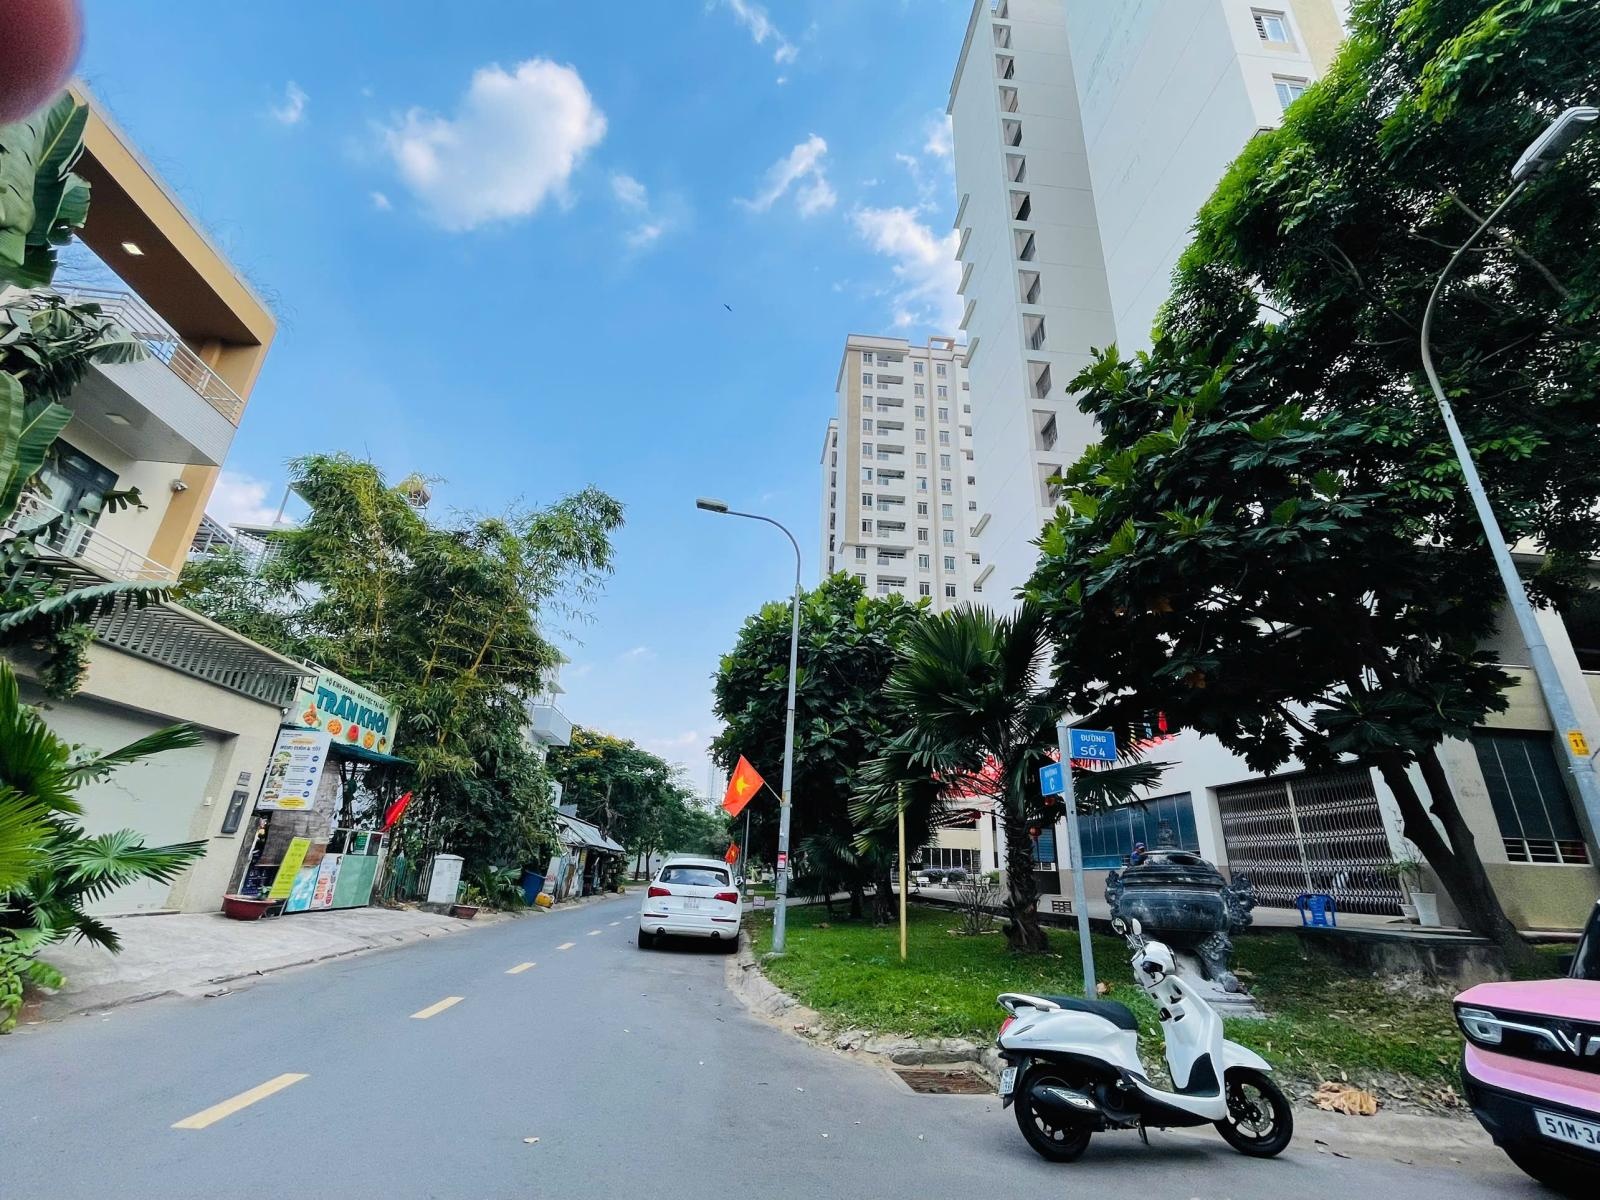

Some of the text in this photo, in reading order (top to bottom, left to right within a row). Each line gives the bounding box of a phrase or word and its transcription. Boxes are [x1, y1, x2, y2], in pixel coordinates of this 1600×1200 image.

[316, 686, 359, 722] TRẦN
[1080, 734, 1106, 743] ĐƯỜNG
[1080, 745, 1106, 757] SỐ 4
